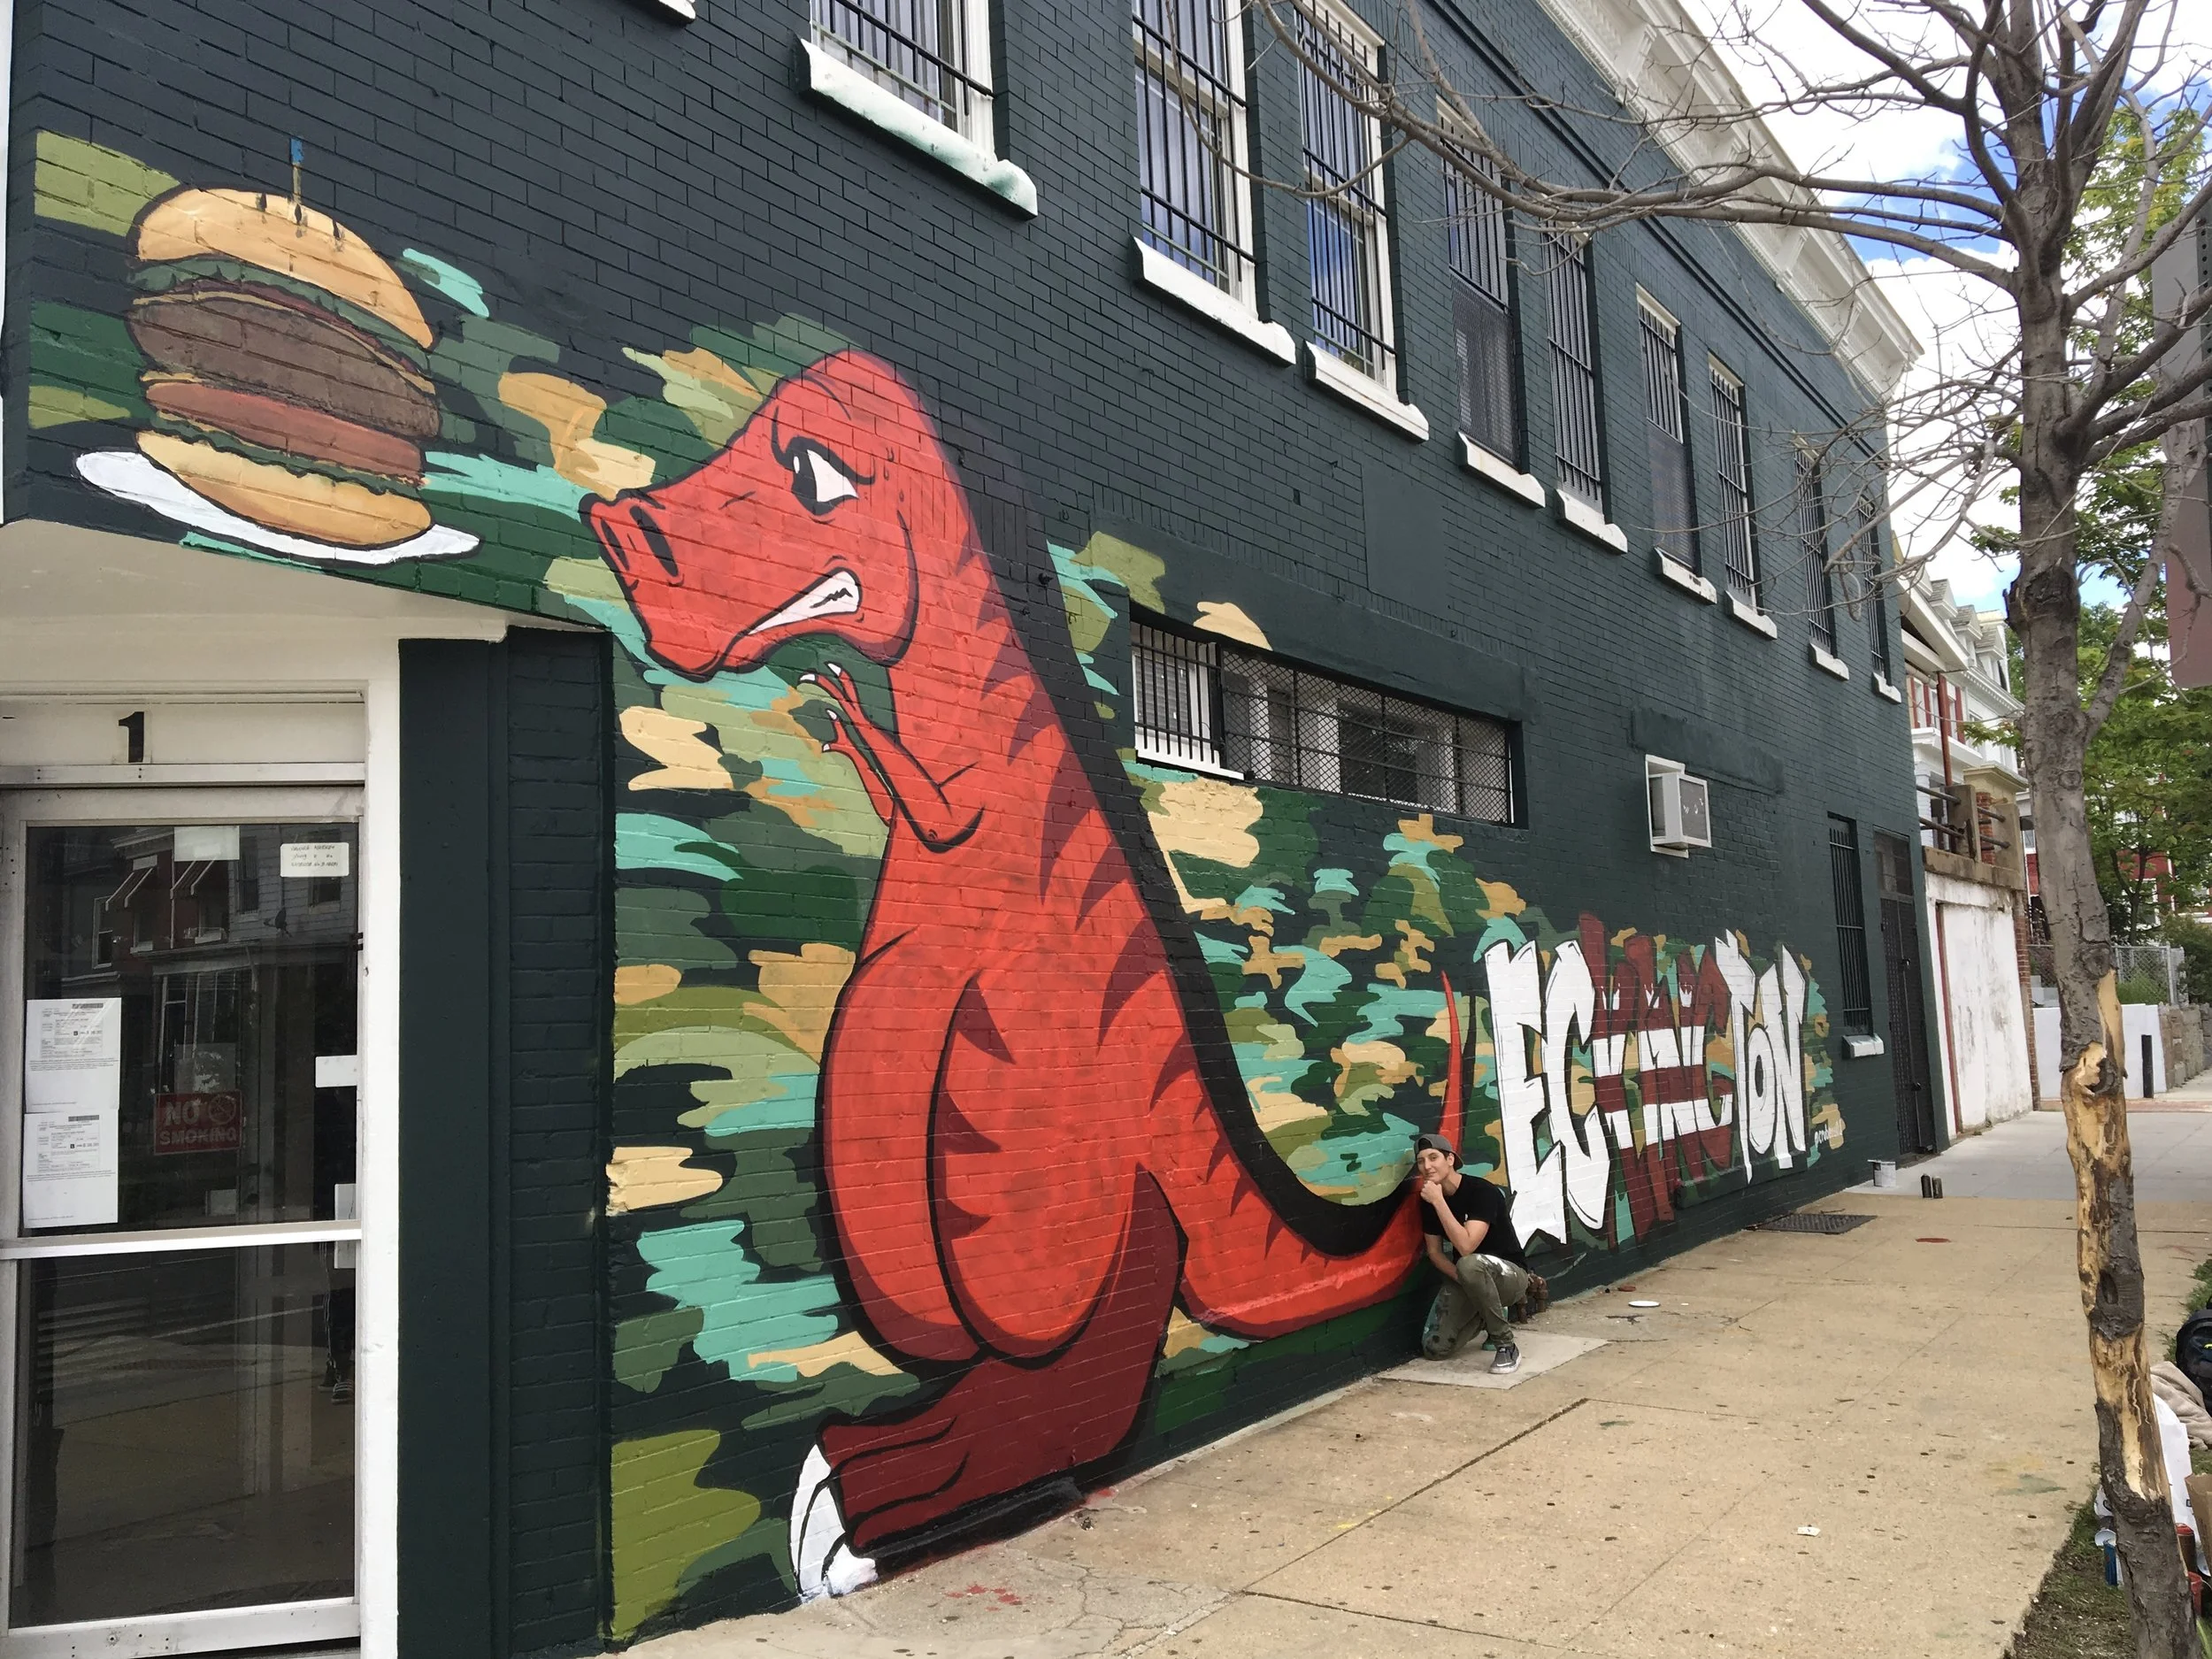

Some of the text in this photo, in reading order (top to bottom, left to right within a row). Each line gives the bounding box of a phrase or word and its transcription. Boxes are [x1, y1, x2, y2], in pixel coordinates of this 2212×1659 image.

[119, 711, 144, 763] 1
[165, 1101, 200, 1125] NO
[160, 1127, 236, 1145] SMOKING
